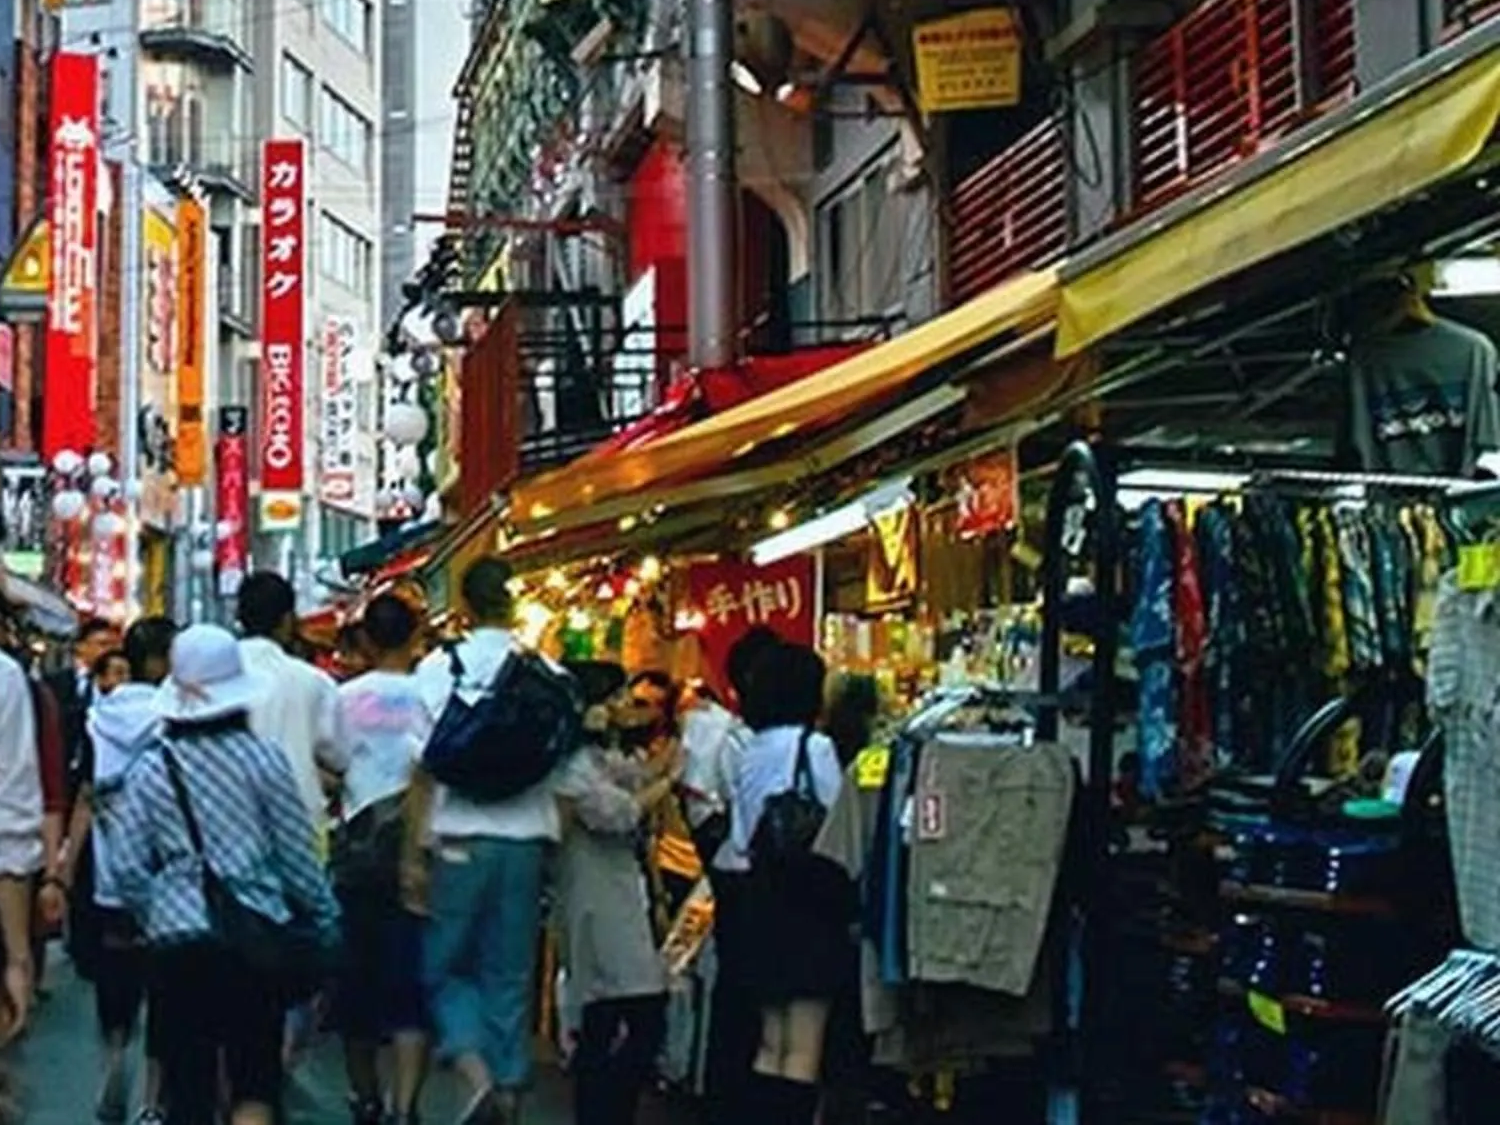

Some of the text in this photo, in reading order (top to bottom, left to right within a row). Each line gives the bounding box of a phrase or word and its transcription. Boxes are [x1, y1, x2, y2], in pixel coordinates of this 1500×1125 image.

[267, 160, 298, 300] カラオケ
[705, 576, 802, 625] 手作り
